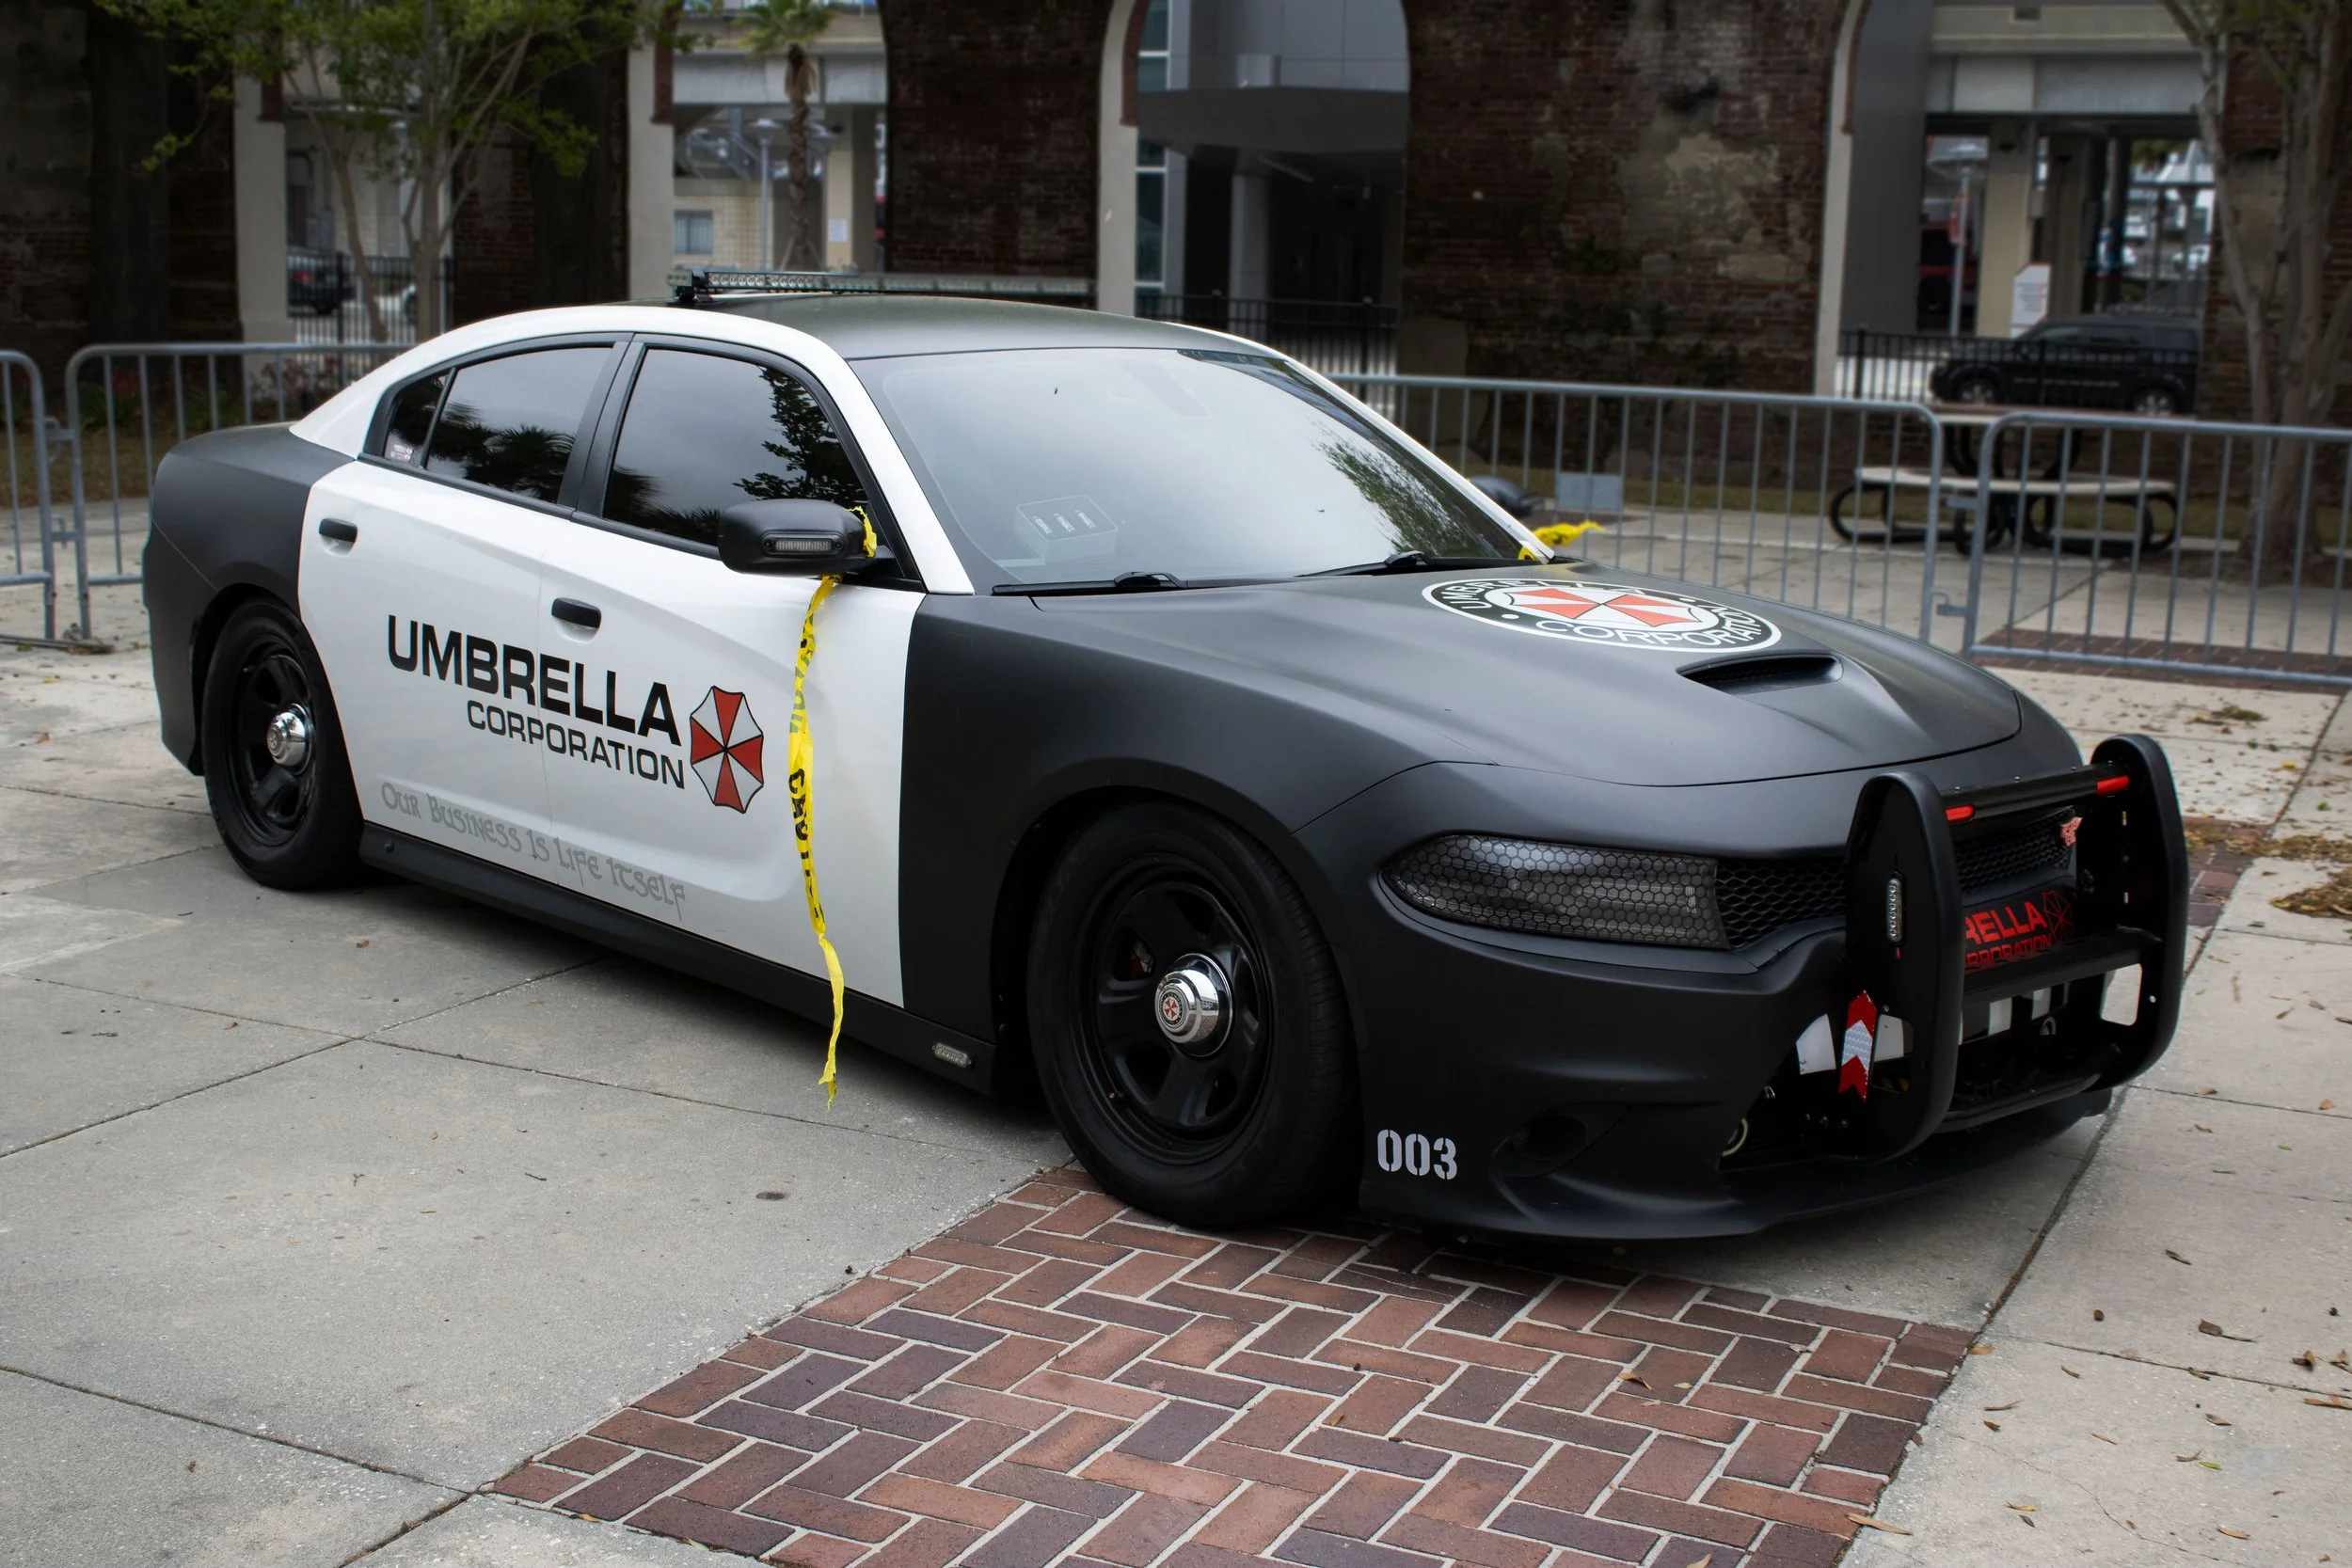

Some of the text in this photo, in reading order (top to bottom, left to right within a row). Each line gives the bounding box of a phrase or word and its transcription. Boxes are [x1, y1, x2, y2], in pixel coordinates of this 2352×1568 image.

[1441, 579, 1647, 610] UMBRELLA
[1535, 604, 1763, 646] CORPORATION
[388, 614, 682, 748] UMBRELLA
[467, 699, 686, 790] CORPORATION
[1964, 900, 2048, 945] RELLA
[1376, 1129, 1458, 1180] 003
